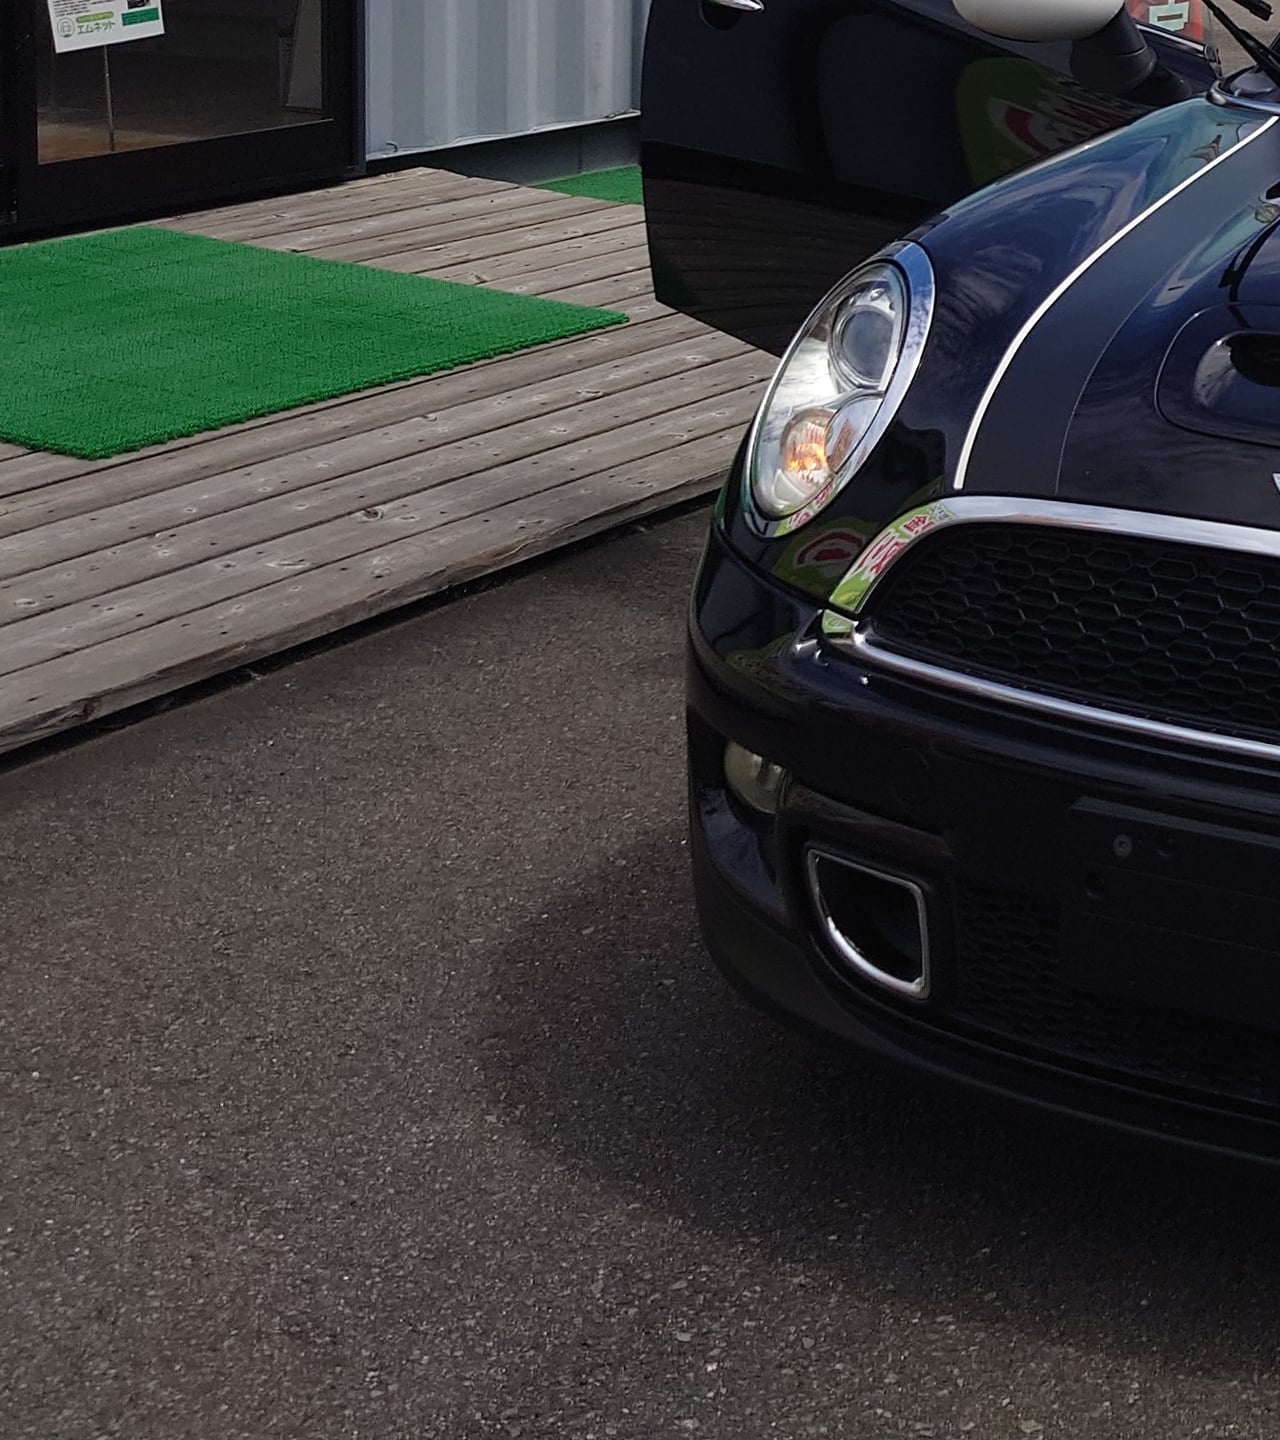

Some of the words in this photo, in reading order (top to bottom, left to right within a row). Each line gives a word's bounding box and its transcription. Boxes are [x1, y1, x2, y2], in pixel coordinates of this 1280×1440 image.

[78, 20, 115, 35] エムネット
